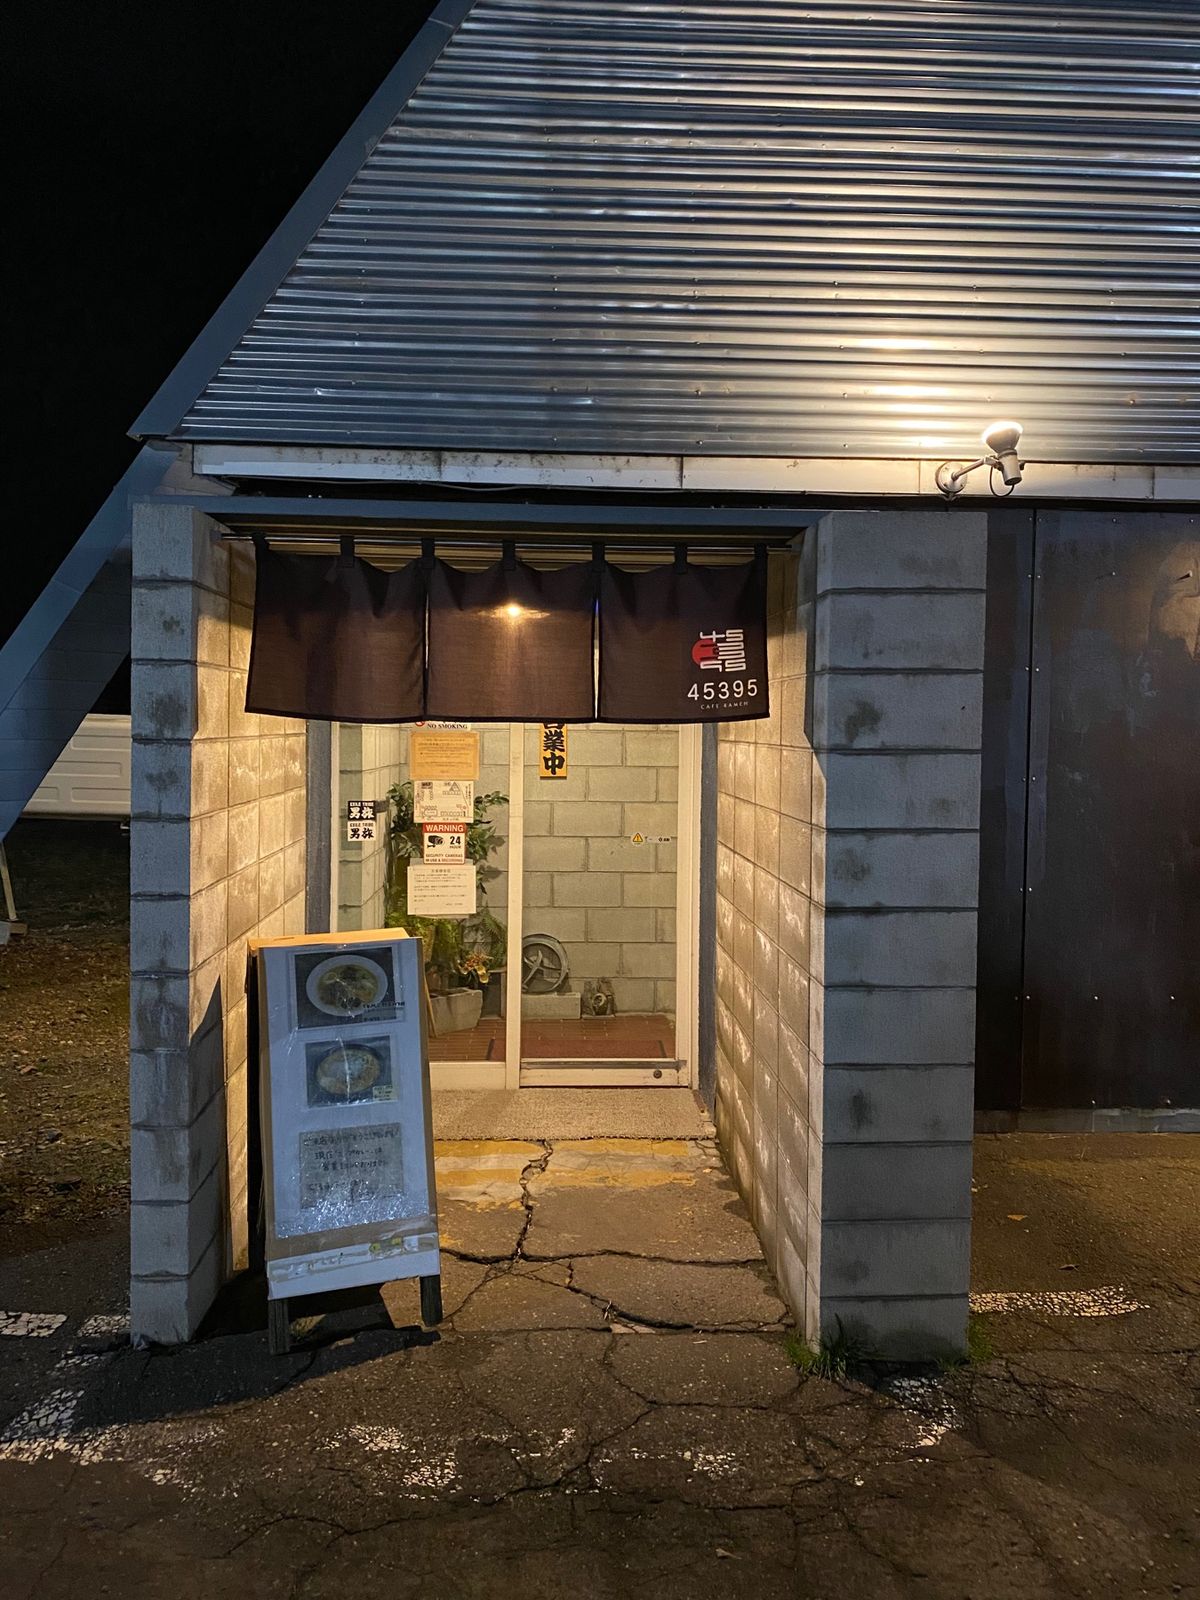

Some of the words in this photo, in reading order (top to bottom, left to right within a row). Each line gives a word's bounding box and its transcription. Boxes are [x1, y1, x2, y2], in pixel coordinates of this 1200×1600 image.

[687, 678, 758, 701] 45395
[349, 806, 375, 819] 男旅
[350, 827, 375, 840] 男旅
[425, 824, 464, 832] WARNING
[449, 836, 461, 845] 24
